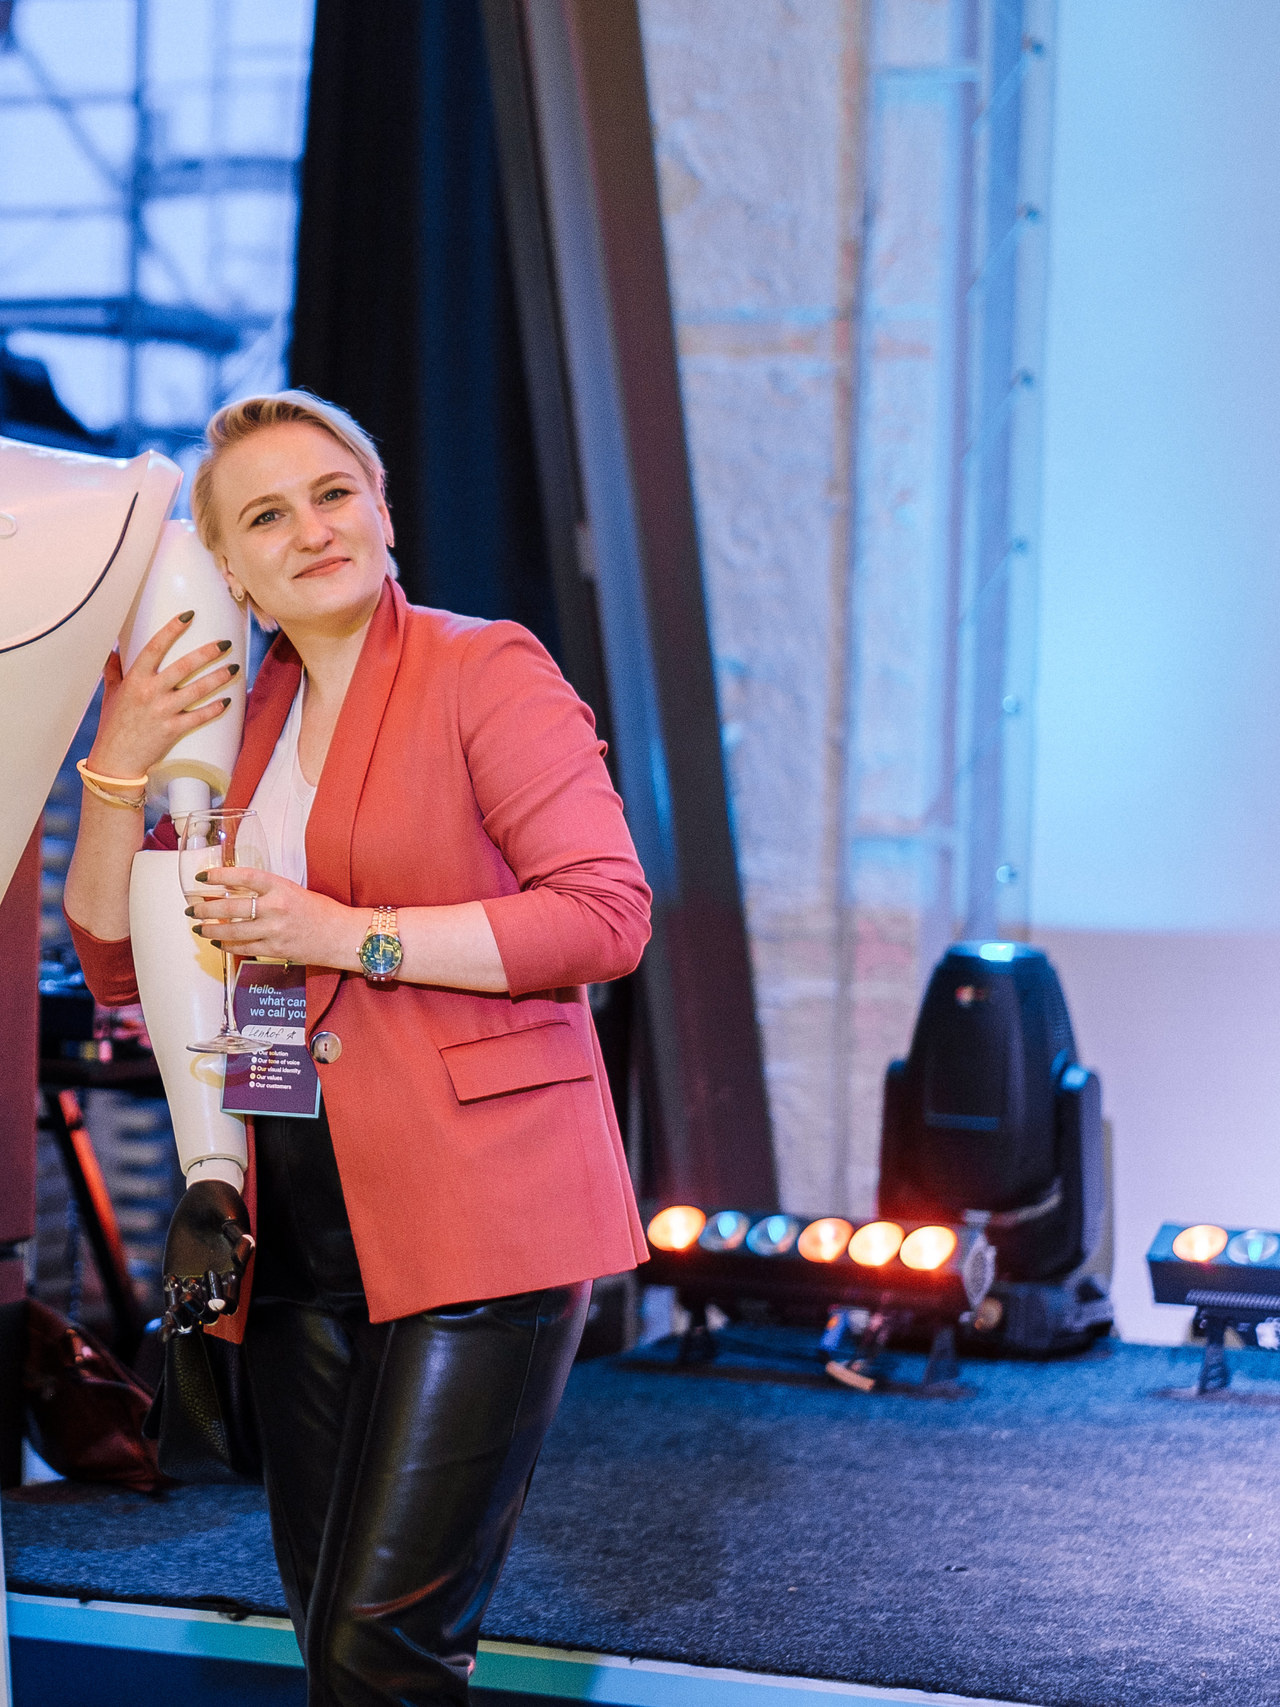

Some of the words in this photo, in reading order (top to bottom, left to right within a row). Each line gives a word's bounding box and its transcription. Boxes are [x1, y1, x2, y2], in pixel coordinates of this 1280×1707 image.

[260, 995, 285, 1006] what
[287, 998, 306, 1007] can
[250, 1008, 265, 1017] we
[267, 1007, 285, 1017] call
[287, 1010, 306, 1020] you
